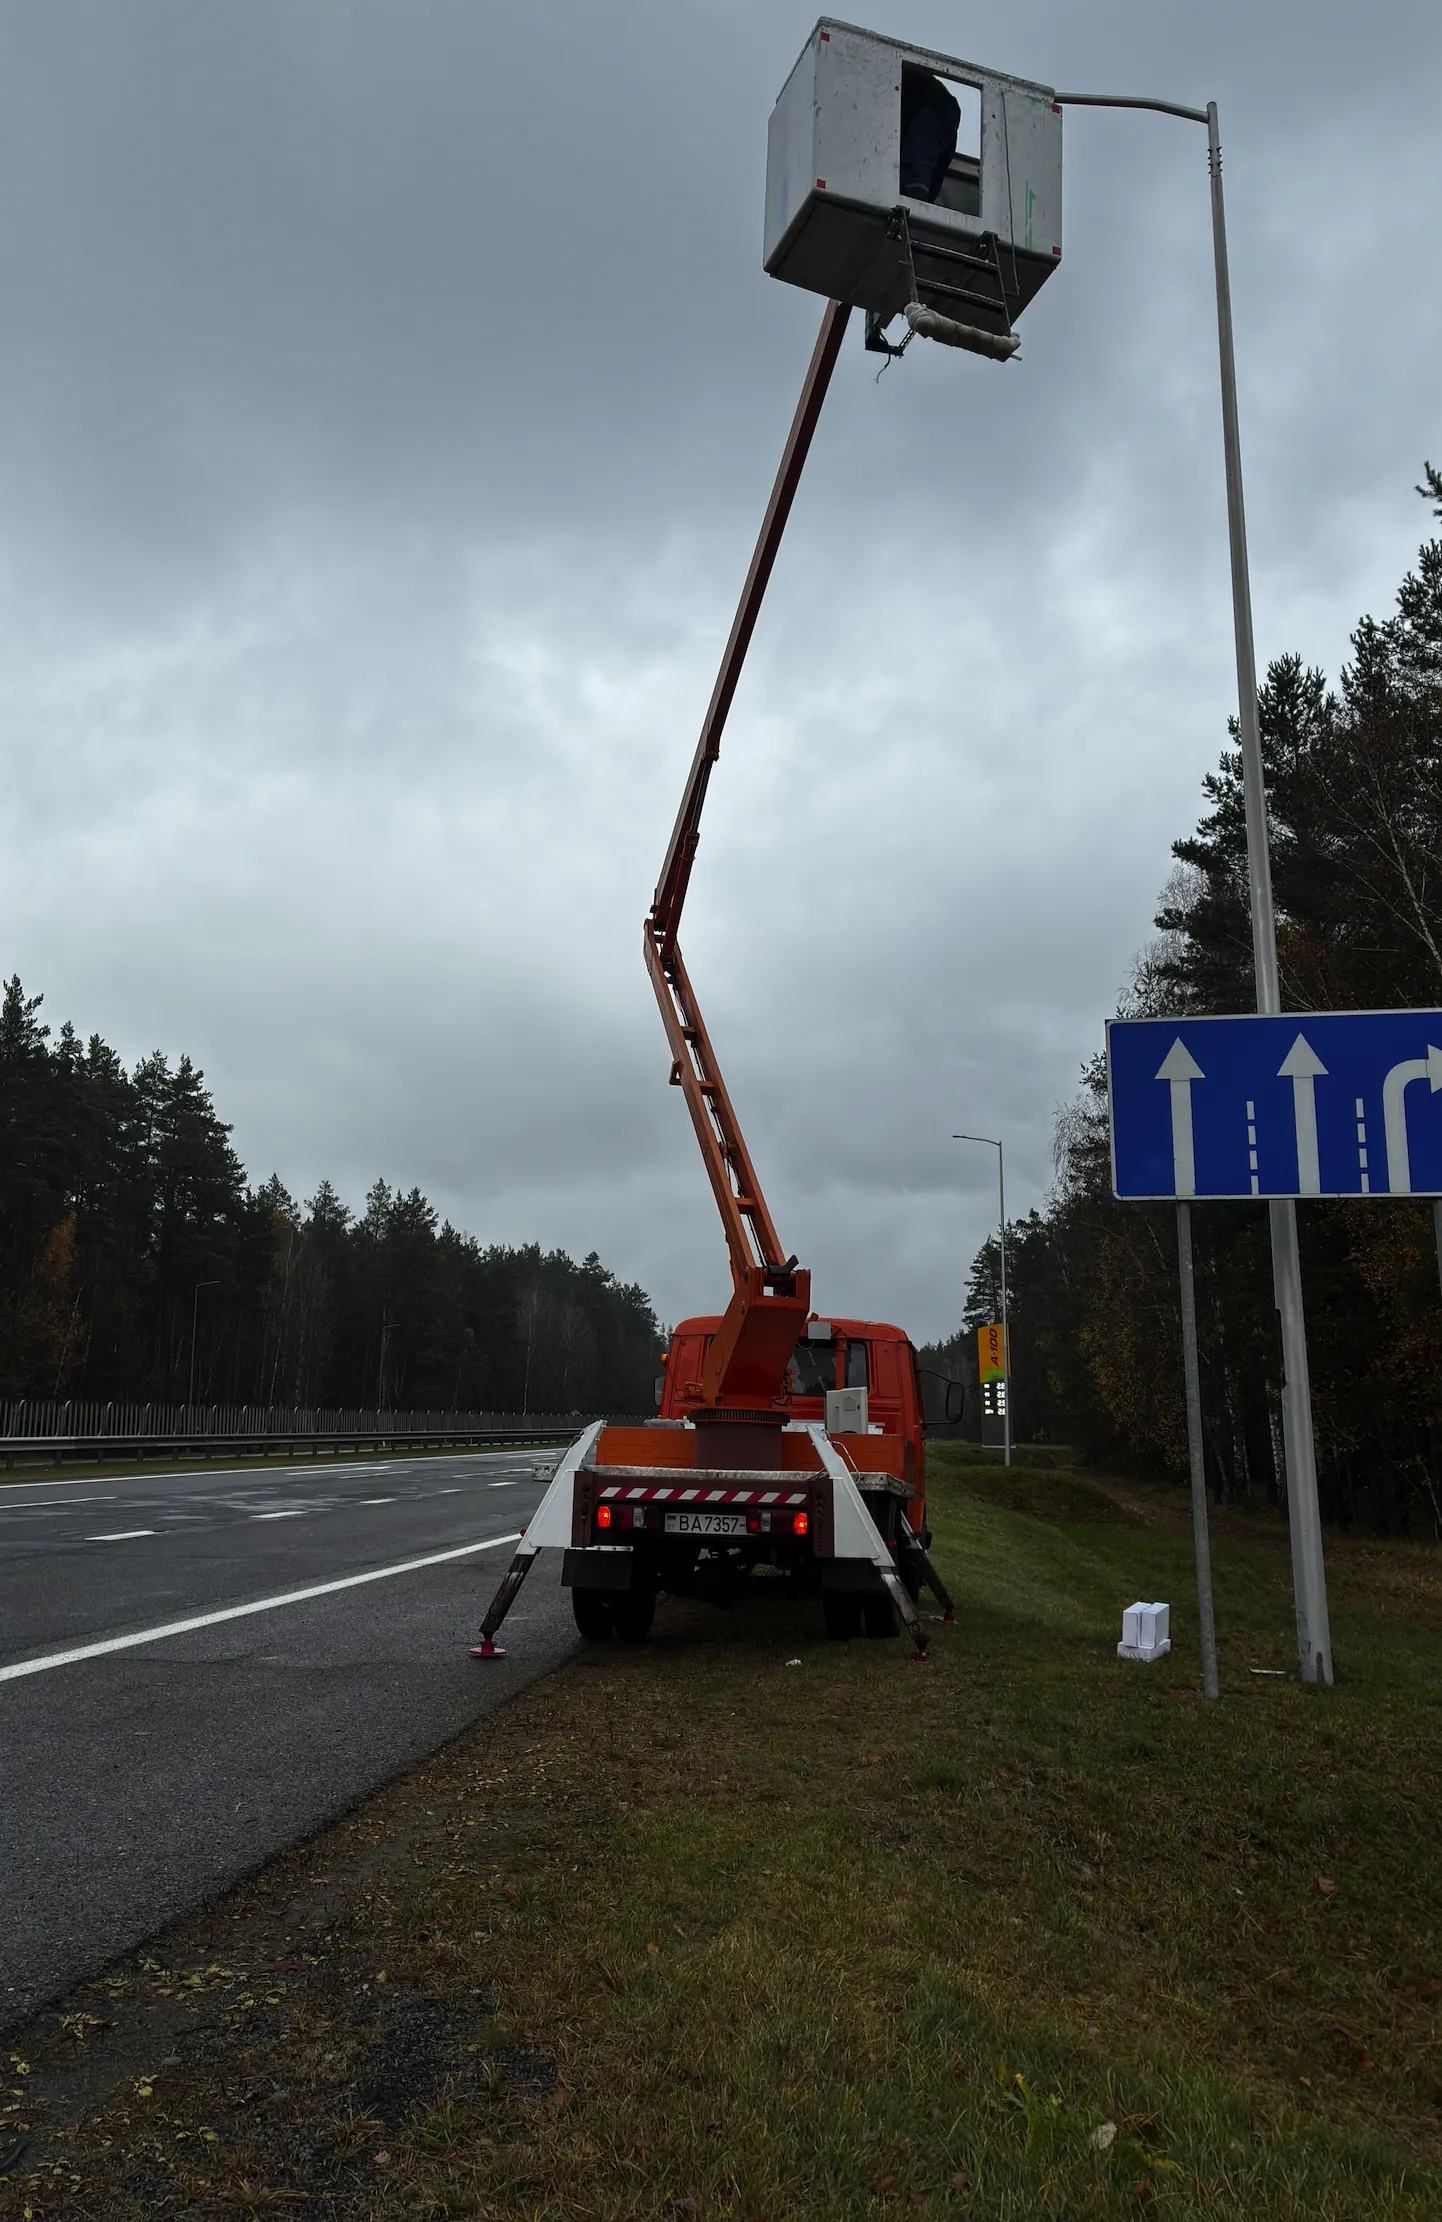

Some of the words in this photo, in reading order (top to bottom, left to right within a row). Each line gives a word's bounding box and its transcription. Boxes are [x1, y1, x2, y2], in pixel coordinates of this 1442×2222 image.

[989, 1328, 999, 1367] A-100
[667, 1523, 676, 1531] BY
[679, 1515, 746, 1533] BA7357-
